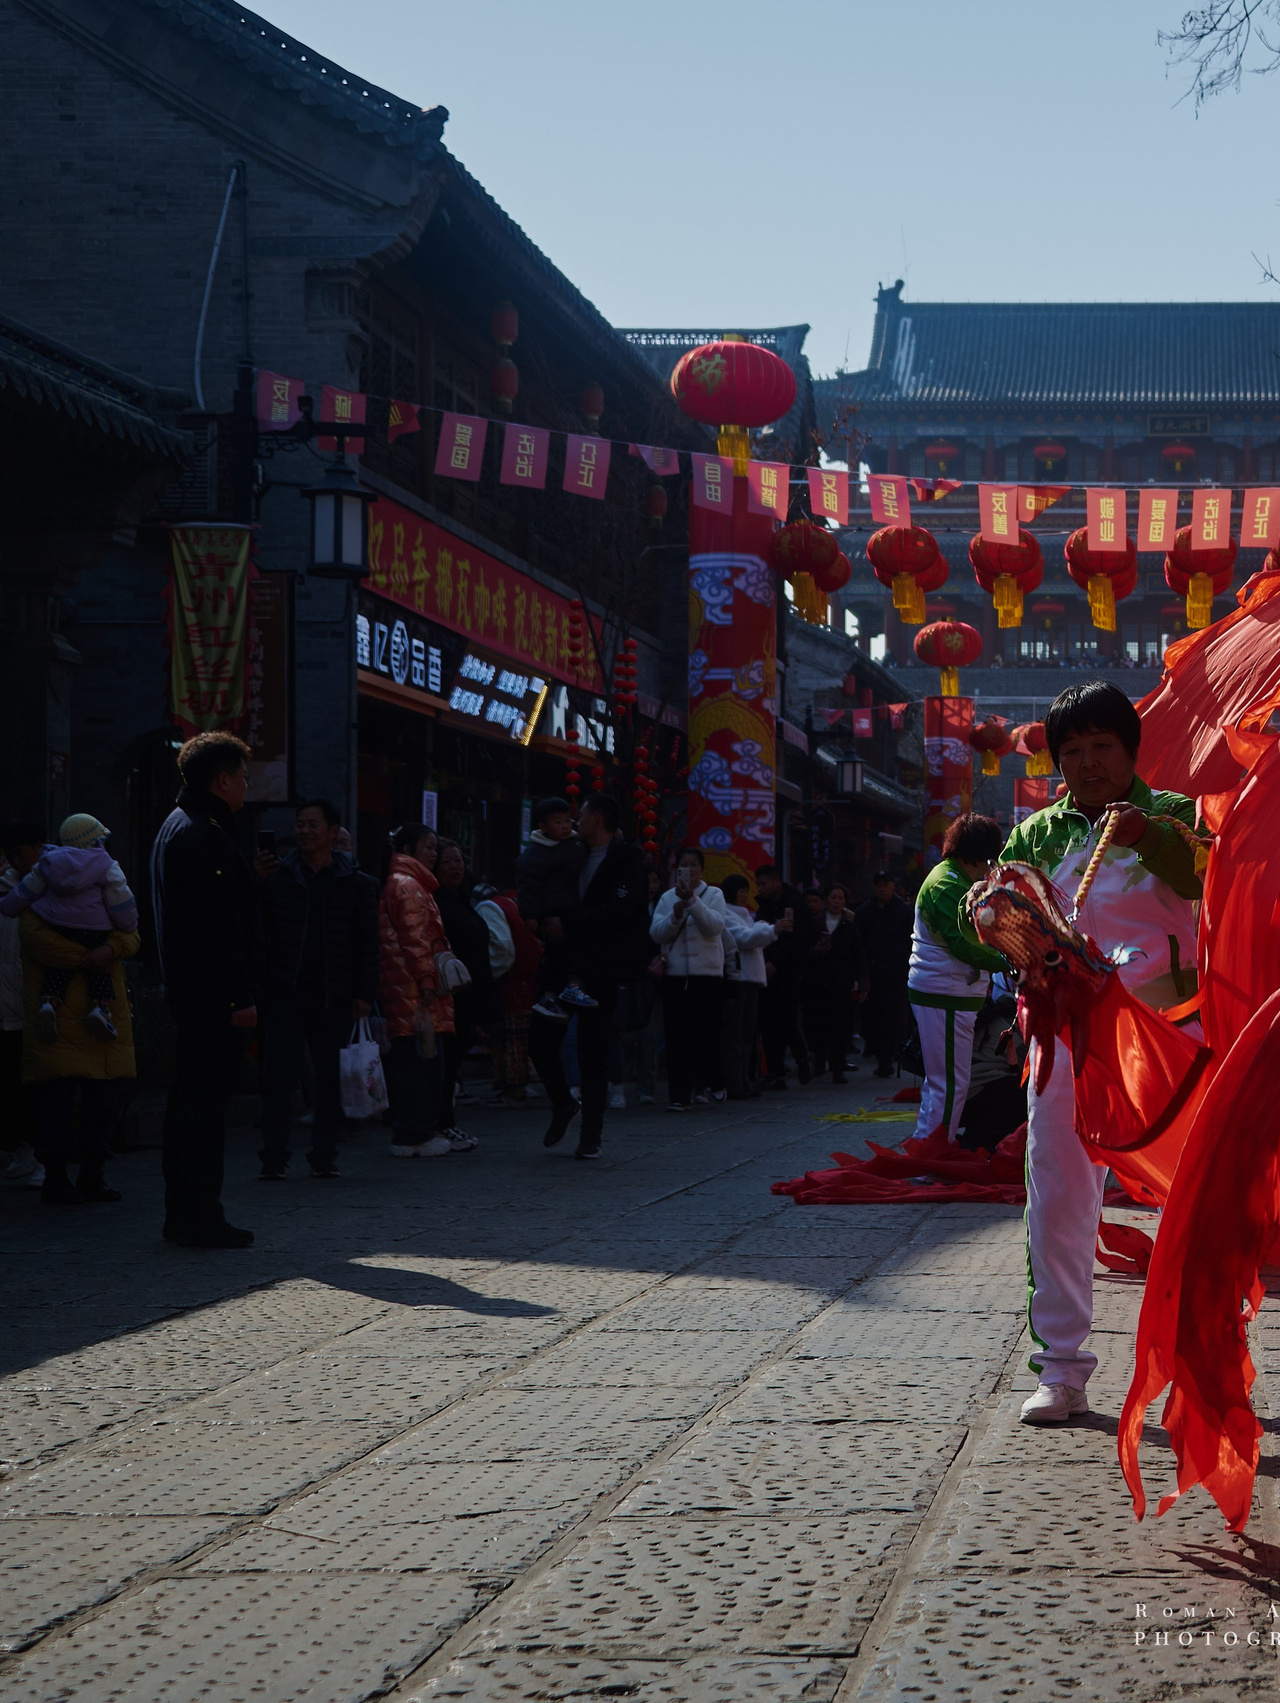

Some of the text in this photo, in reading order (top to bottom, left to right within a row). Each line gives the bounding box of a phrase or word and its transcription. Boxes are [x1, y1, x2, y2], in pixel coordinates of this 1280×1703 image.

[179, 552, 240, 717] 青州红丝砚
